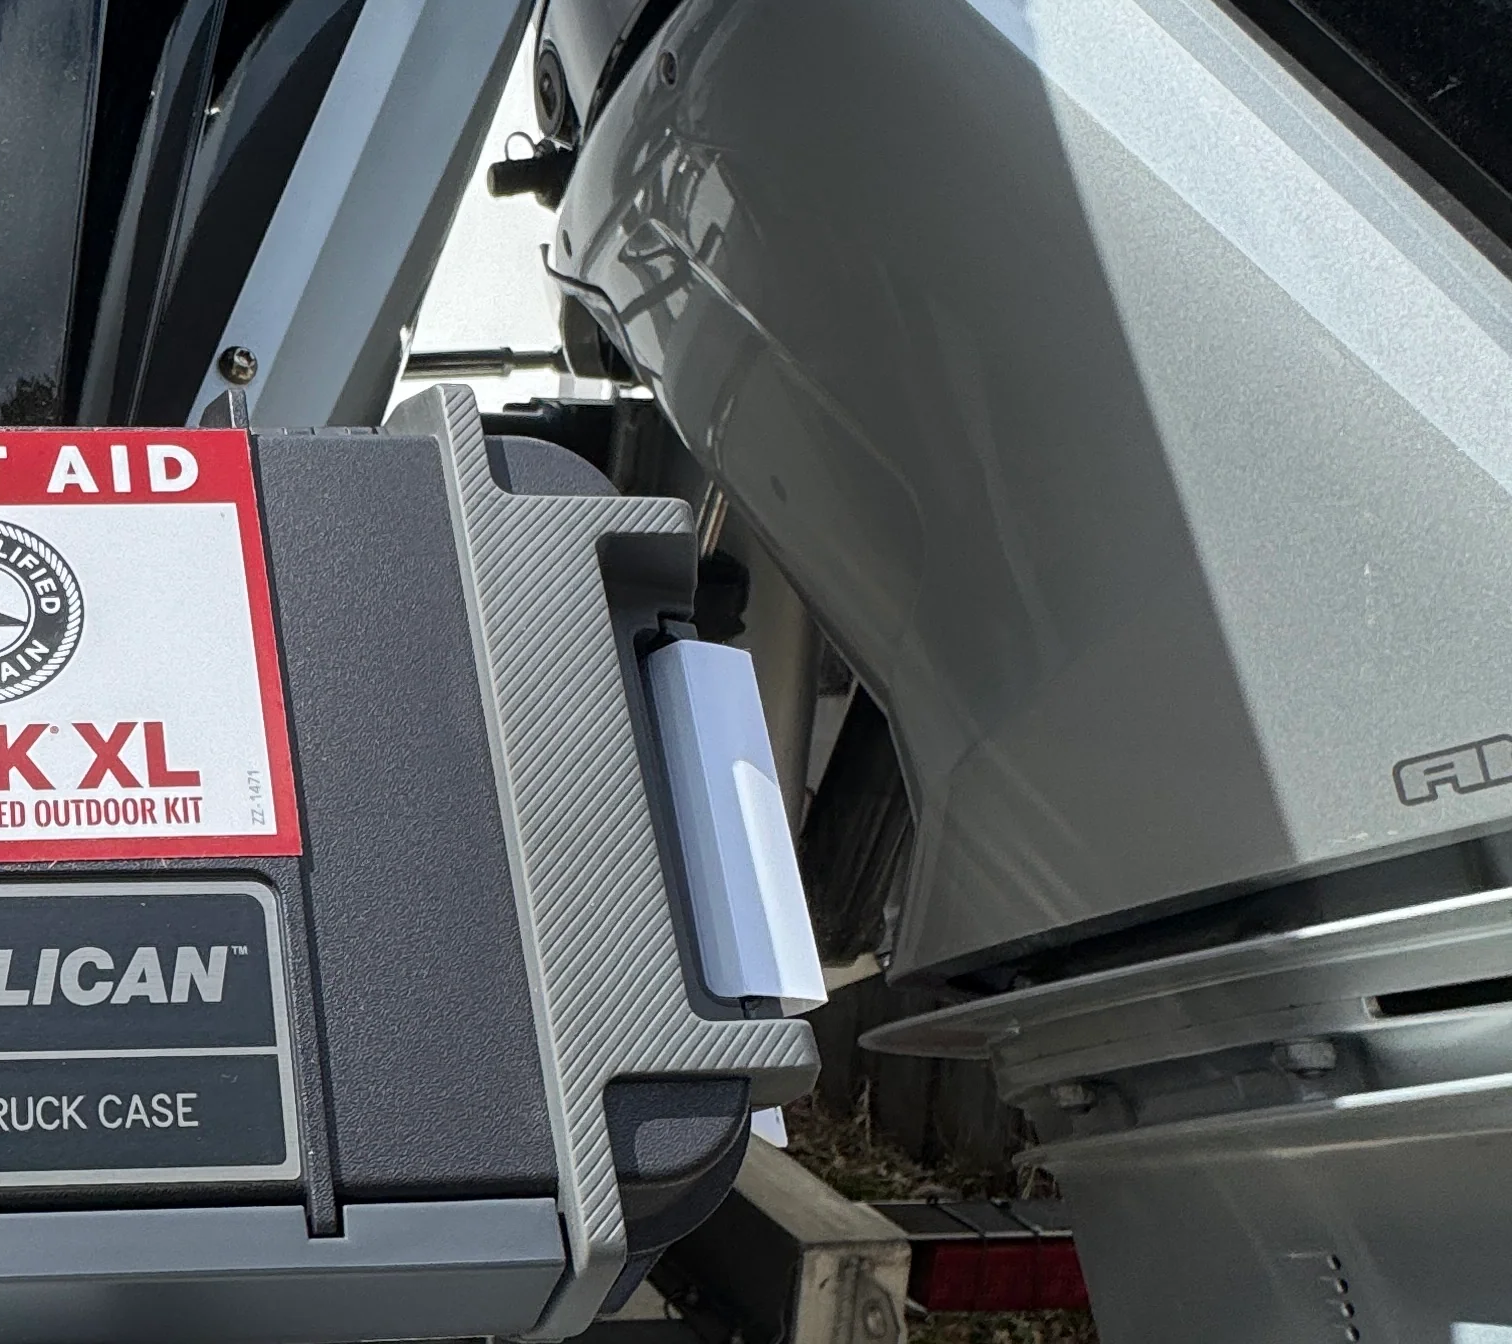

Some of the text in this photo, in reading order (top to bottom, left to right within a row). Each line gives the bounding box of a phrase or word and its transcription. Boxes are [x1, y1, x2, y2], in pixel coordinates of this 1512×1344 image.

[47, 443, 200, 494] AID
[70, 721, 201, 790] XL
[35, 798, 157, 827] OUTDOOR
[165, 796, 203, 825] KIT
[249, 768, 265, 826] ZZ-1471
[98, 1093, 199, 1128] CASE
